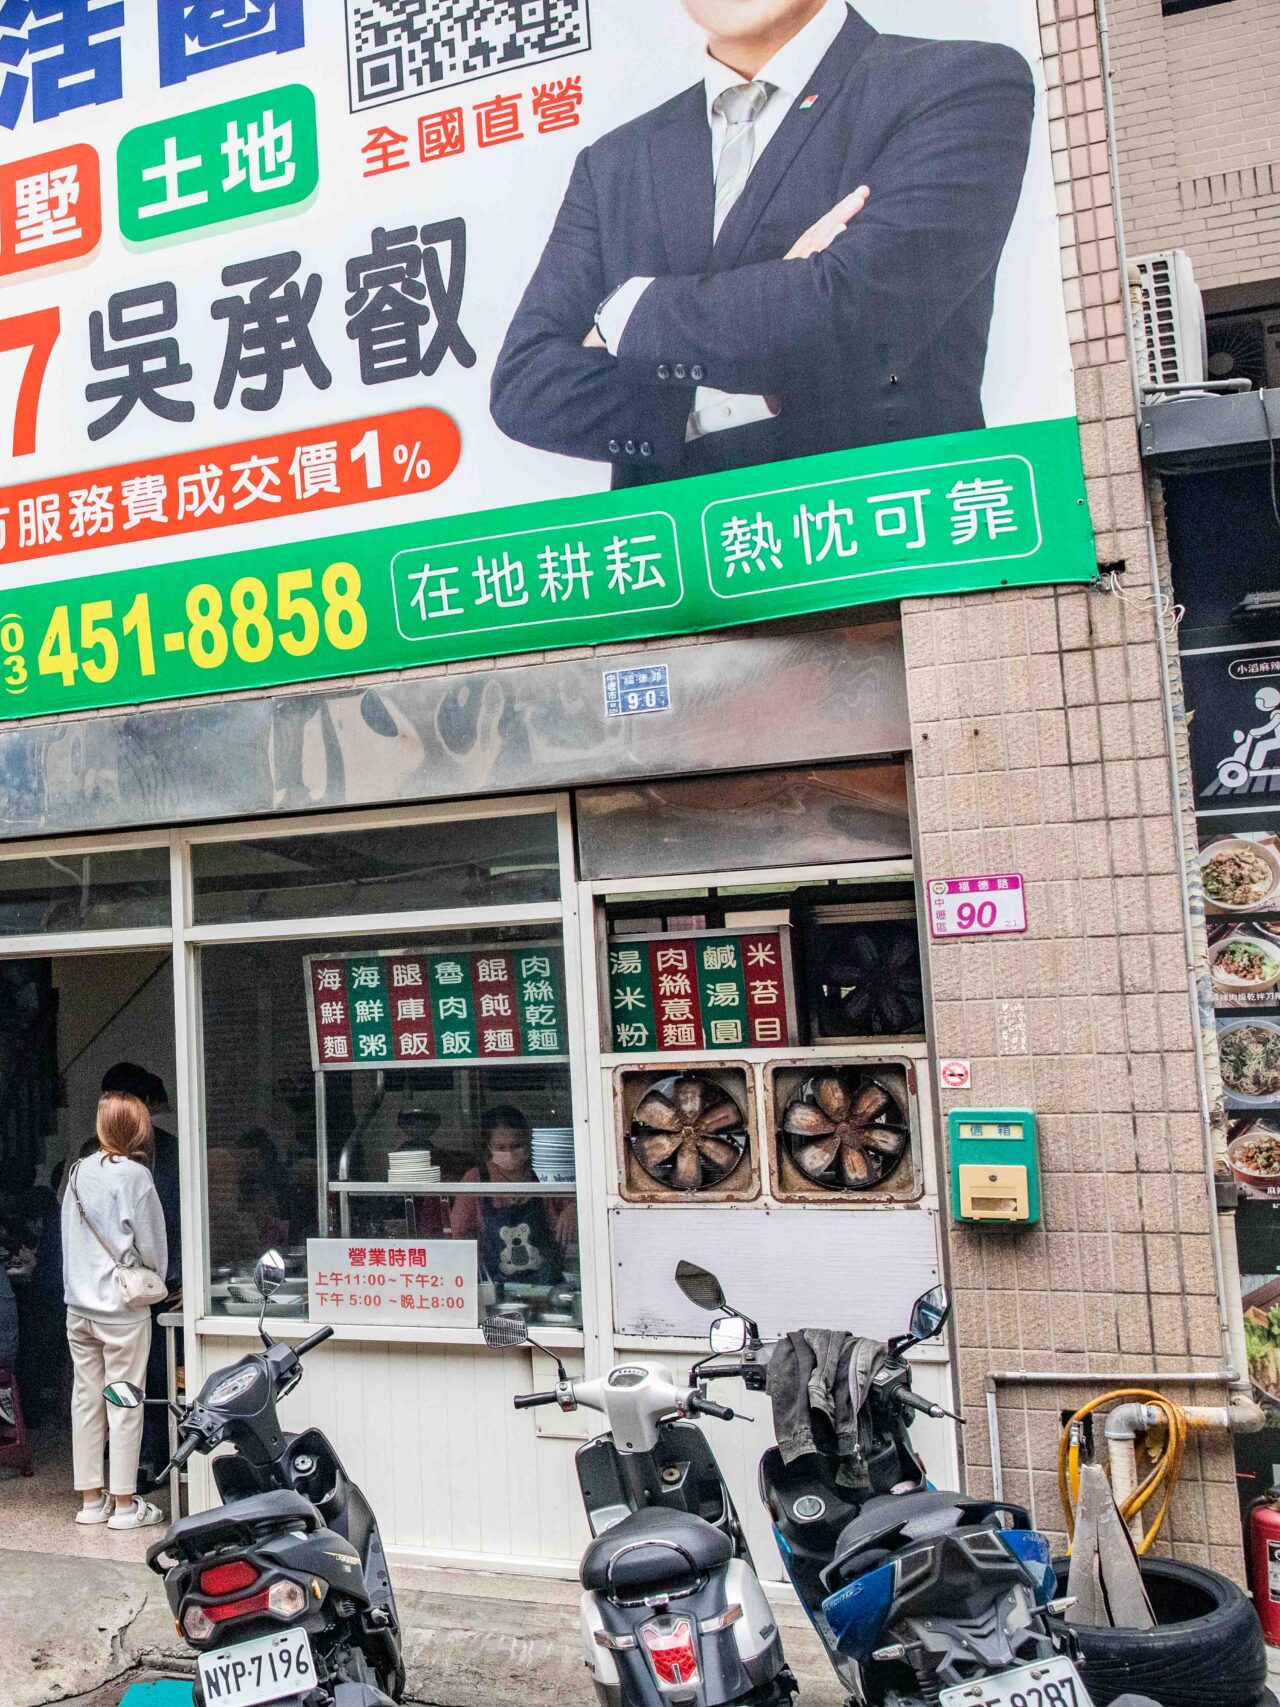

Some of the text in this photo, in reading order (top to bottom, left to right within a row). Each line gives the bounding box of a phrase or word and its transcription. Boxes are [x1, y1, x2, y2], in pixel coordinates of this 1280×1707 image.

[137, 101, 297, 224] 土地
[361, 75, 584, 180] 全國直營
[86, 216, 478, 443] 吳承叡
[718, 477, 1021, 579] 熱忱可靠
[37, 561, 368, 687] 451-8858
[407, 533, 667, 622] 在地耕耘
[627, 690, 656, 709] 90
[957, 900, 997, 930] 90
[317, 967, 349, 1060] 海鮮麵
[351, 966, 388, 1058] 海鮮粥
[392, 962, 430, 1057] 腿庫飯
[434, 960, 473, 1056] 魯肉飯
[475, 957, 516, 1054] 餛飩麵
[520, 954, 560, 1053] 肉絲乾麵
[610, 950, 651, 1050] 湯米粉
[655, 946, 698, 1047] 肉絲意麵
[703, 943, 743, 1045] 鹹湯圓
[746, 942, 783, 1042] 米苔目
[348, 1247, 427, 1268] 營業時間
[203, 1642, 310, 1701] NYP-7196
